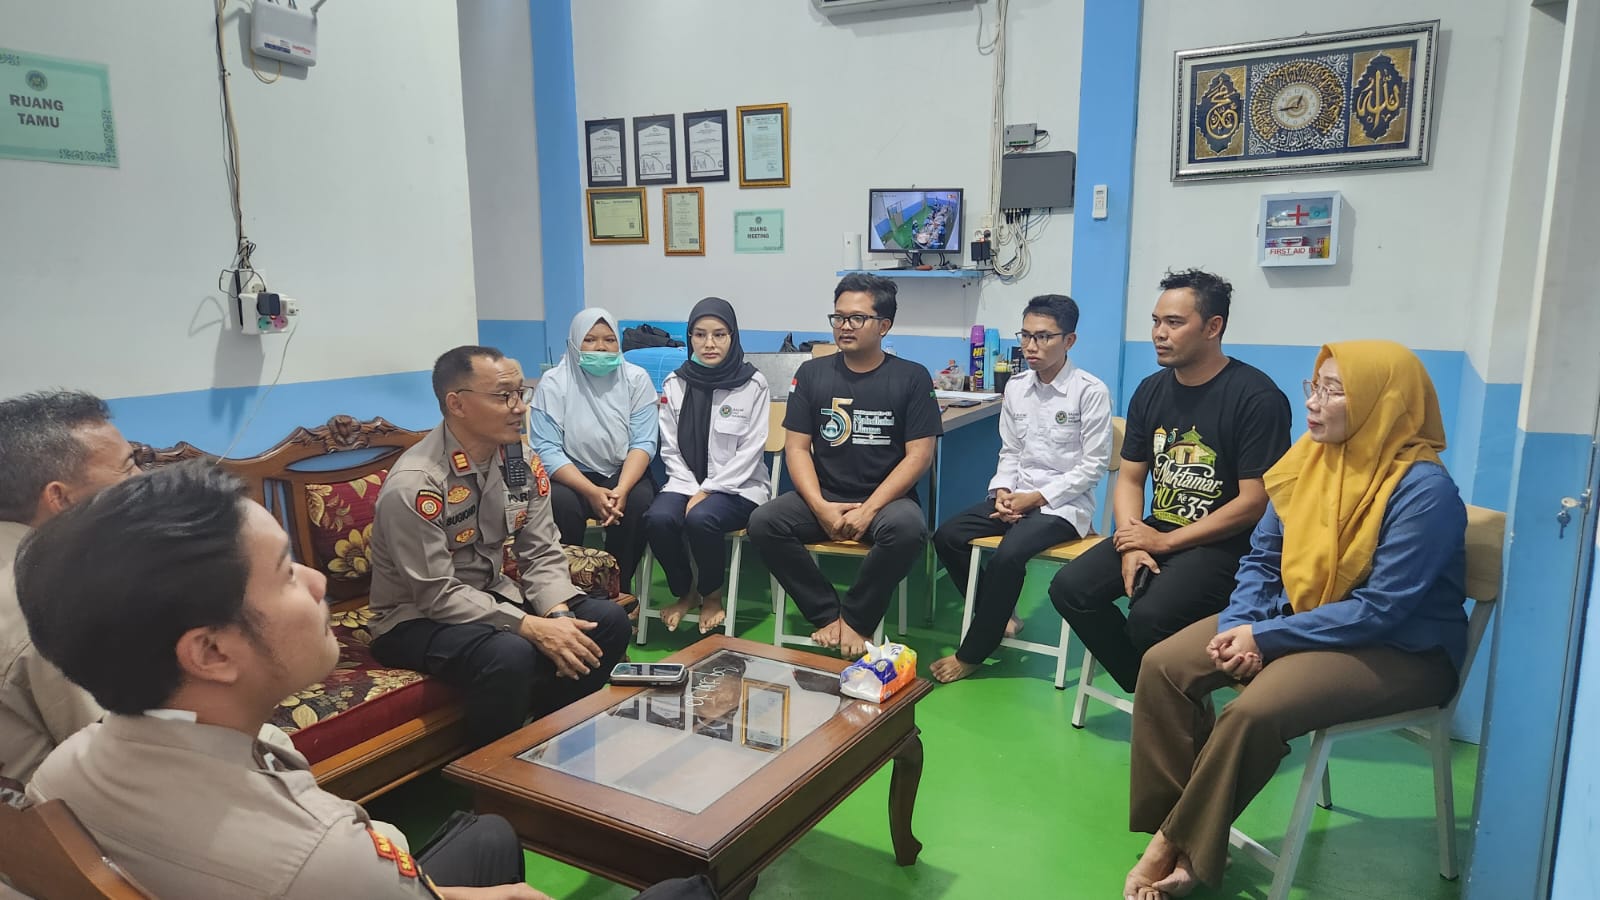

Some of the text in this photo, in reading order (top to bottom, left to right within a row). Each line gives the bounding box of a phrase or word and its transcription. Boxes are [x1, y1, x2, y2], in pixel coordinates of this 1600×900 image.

[9, 94, 64, 111] RUANG
[17, 112, 60, 128] TAMU
[1270, 247, 1291, 255] FIRST
[1153, 454, 1223, 493] Muktamar
[1177, 497, 1214, 521] 35
